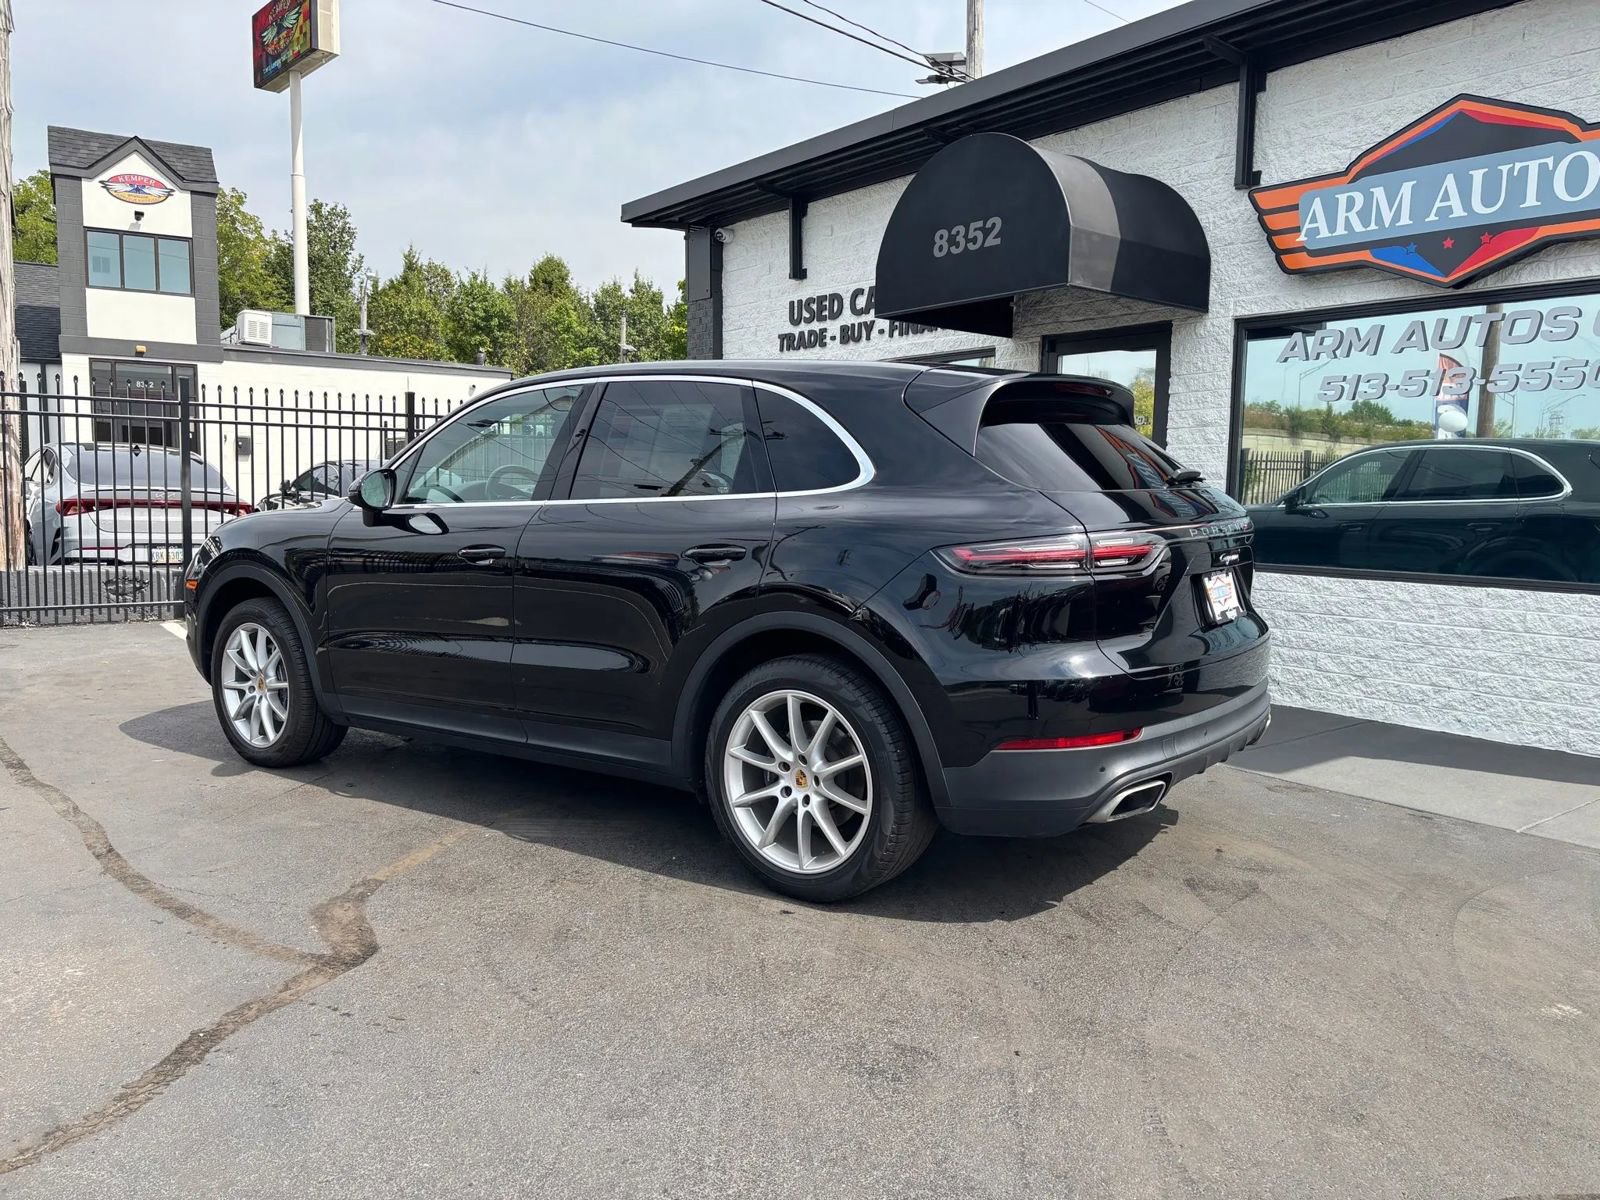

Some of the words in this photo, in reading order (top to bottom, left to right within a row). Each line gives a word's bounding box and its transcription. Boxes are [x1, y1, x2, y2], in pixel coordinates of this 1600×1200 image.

[117, 175, 155, 186] KEMPER
[1296, 180, 1417, 242] ARM
[933, 216, 1002, 258] 8352
[789, 293, 843, 326] USED
[778, 328, 827, 352] TRADE
[840, 320, 875, 345] BUY
[1276, 324, 1385, 363] ARM
[1390, 306, 1583, 356] AUTOS
[136, 380, 155, 389] 832
